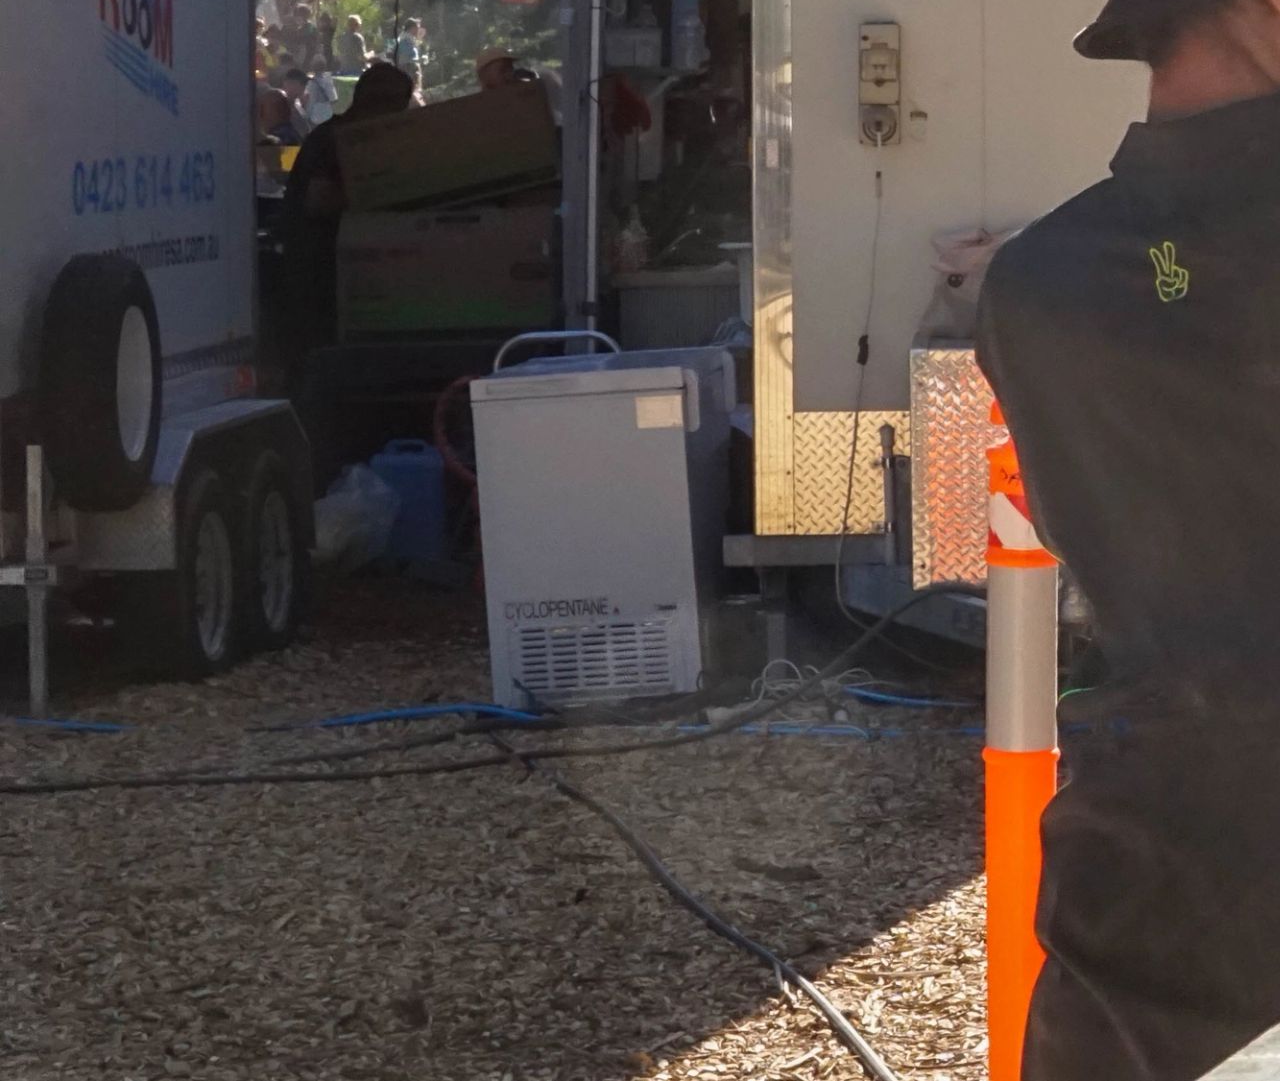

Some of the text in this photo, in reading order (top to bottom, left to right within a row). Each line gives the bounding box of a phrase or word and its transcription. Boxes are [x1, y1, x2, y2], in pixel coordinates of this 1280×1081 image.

[72, 156, 127, 217] 0423
[134, 153, 173, 210] 614
[503, 597, 610, 621] CYCLOPENTANE
